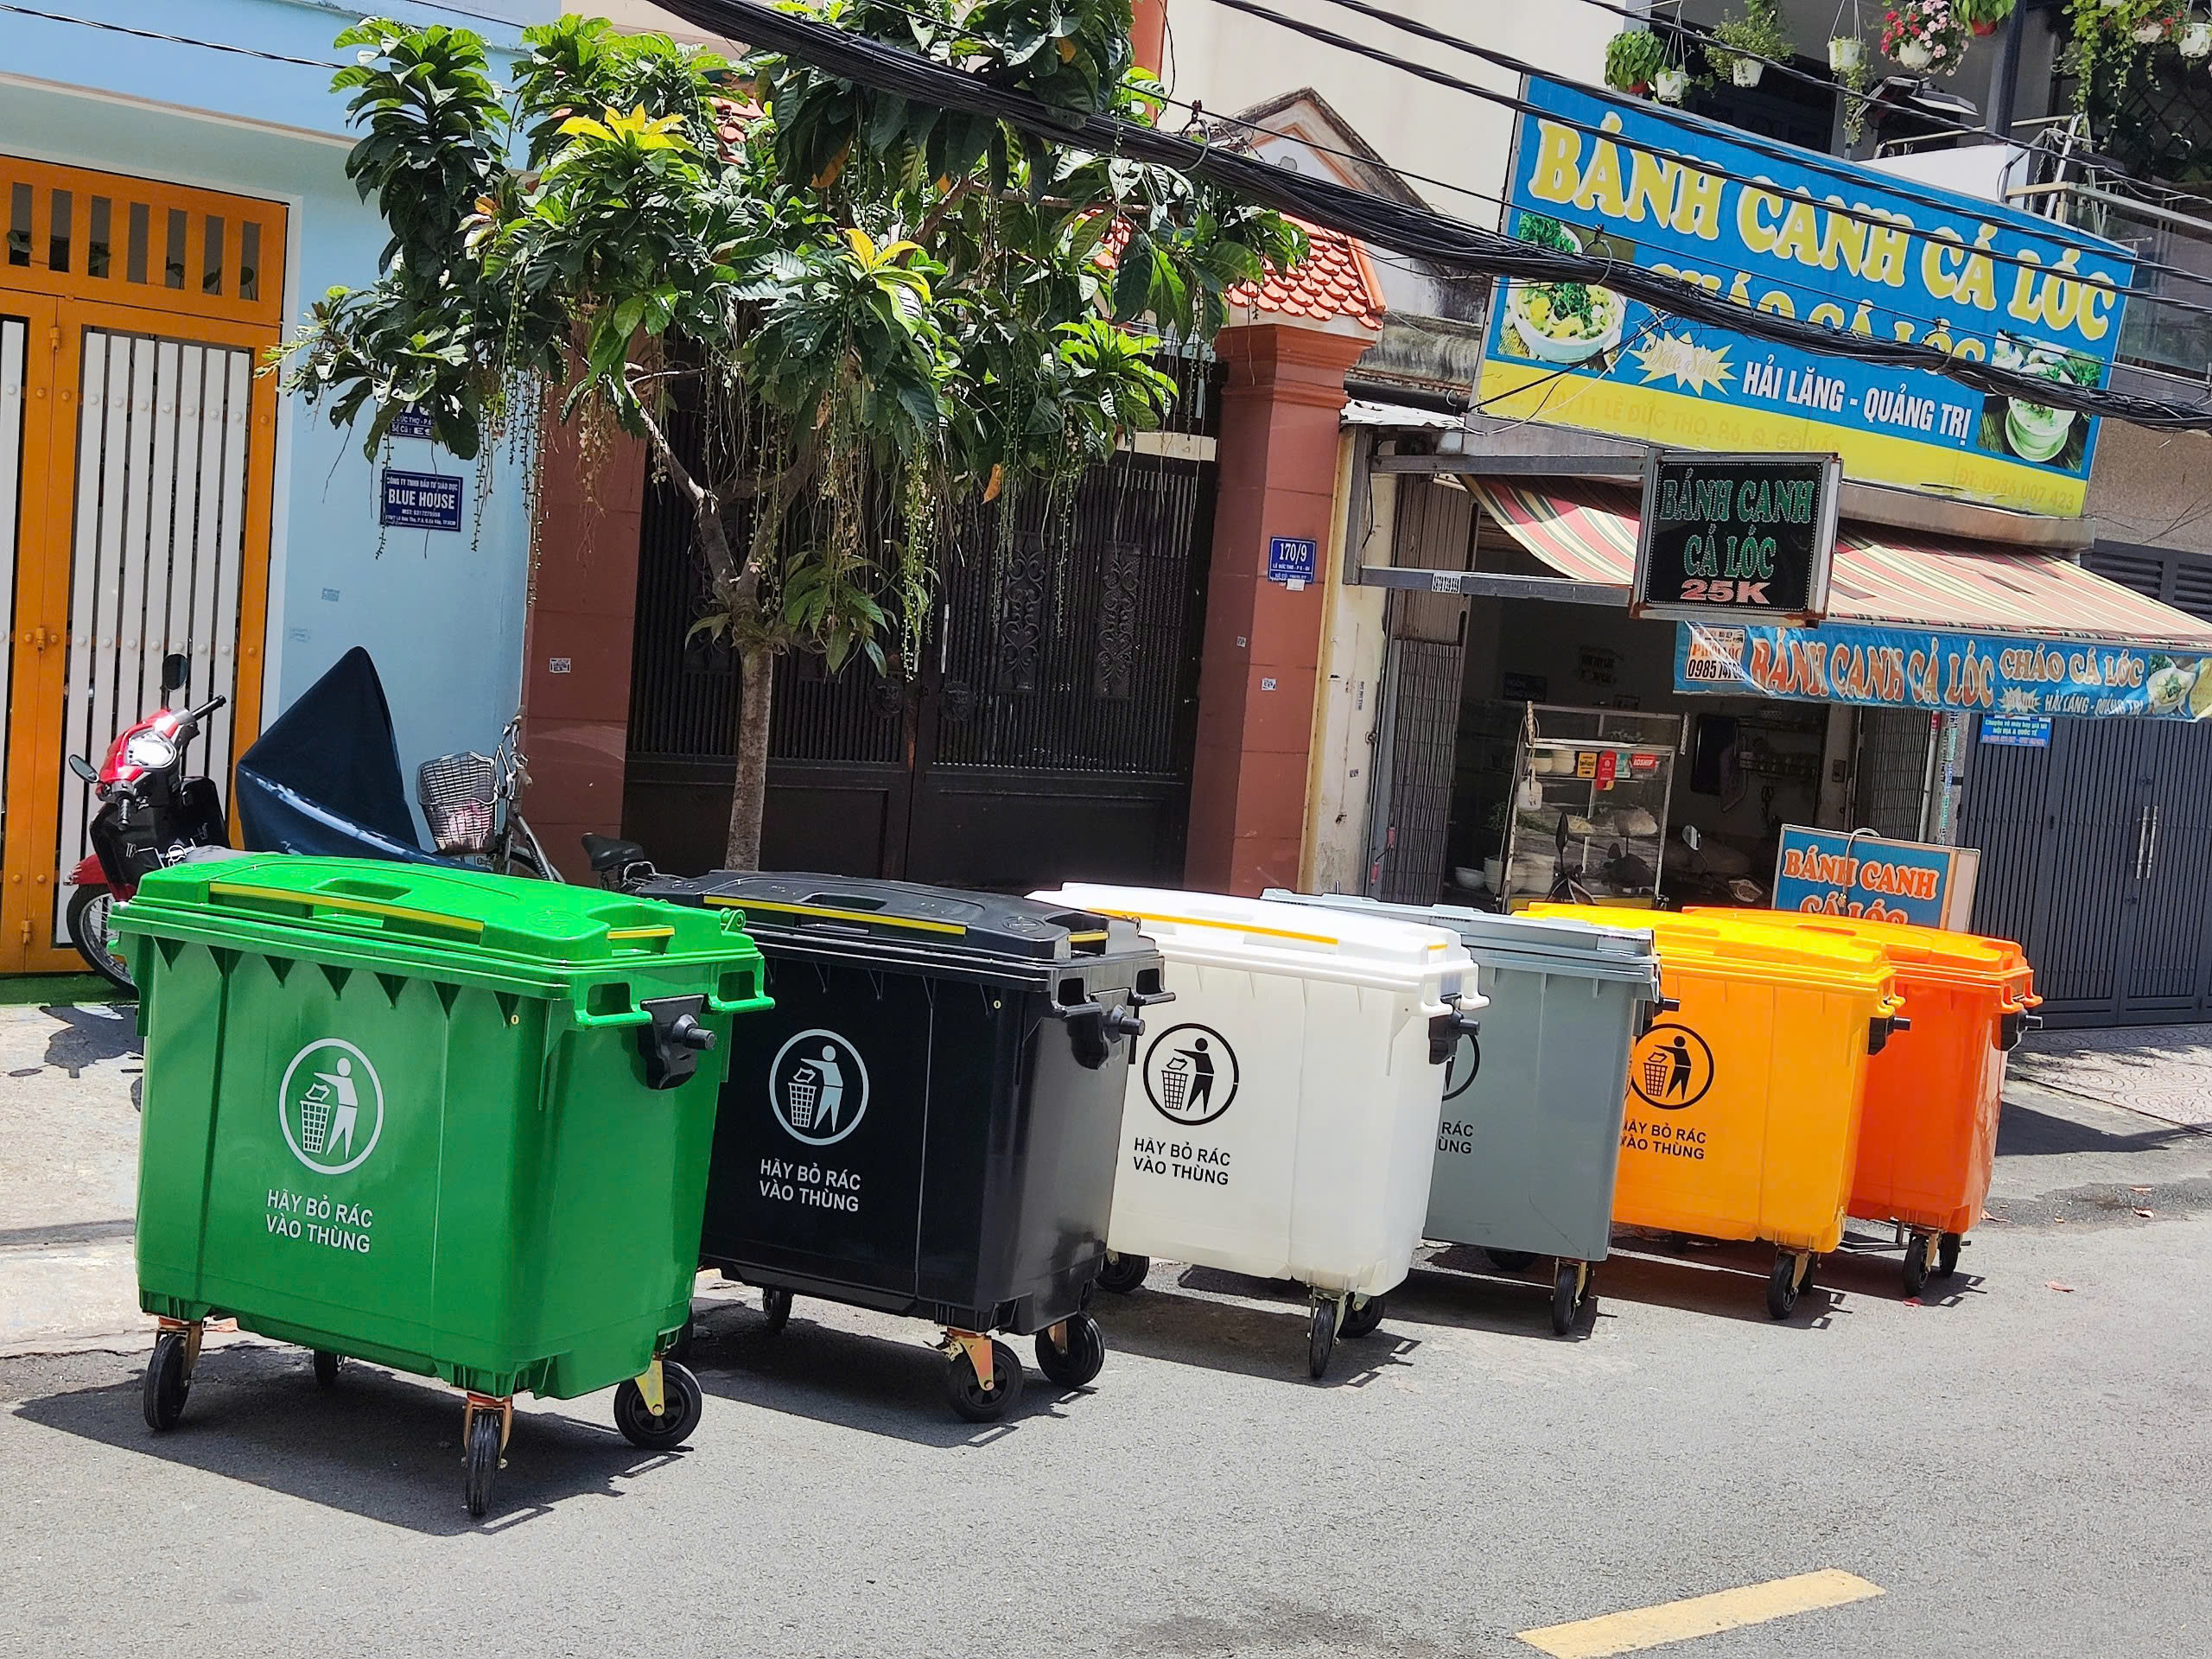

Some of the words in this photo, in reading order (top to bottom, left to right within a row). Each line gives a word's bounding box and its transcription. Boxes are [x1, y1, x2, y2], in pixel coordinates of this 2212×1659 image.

[1528, 111, 1726, 240] BÁNH
[1738, 175, 1914, 288] CANH
[1922, 222, 1999, 311] CÁ
[2007, 247, 2116, 340] LÓC
[1742, 353, 1783, 400] HẢI
[1786, 365, 1846, 413] LĂNG
[1863, 383, 1936, 431] QUẢNG
[1939, 403, 1972, 446] TRỊ
[388, 488, 416, 506] BLUE
[418, 491, 454, 510] HOUSE
[1659, 467, 1733, 522] BÁNH
[1737, 480, 1815, 524] CANH
[2020, 483, 2047, 504] 007
[2050, 490, 2075, 511] 423
[1279, 543, 1307, 565] 170/9
[1684, 523, 1719, 577] CÁ
[1724, 524, 1777, 580] LÓC
[1680, 579, 1771, 605] 25K
[1750, 626, 1828, 697] BÁNH
[1830, 642, 1904, 702] CANH
[1907, 636, 1941, 704] CÁ
[1944, 639, 1994, 709] LÓC
[1999, 642, 2065, 683] CHÁO
[2069, 646, 2101, 685] CÁ
[2104, 648, 2145, 689] LÓC
[1783, 844, 1859, 887] BÁNH
[1859, 861, 1940, 900] CANH
[1438, 1135, 1471, 1154] ÙNG
[1441, 1120, 1474, 1137] RÁC
[1651, 1122, 1672, 1139] BỎ
[1675, 1128, 1707, 1144] RÁC
[1134, 1136, 1166, 1155] HÃY
[1170, 1141, 1192, 1160] BỎ
[1197, 1147, 1230, 1166] RÁC
[1621, 1134, 1648, 1150] VÀO
[1652, 1141, 1705, 1160] THÙNG
[760, 1158, 793, 1179] HÃY
[797, 1162, 821, 1184] BỎ
[825, 1168, 861, 1191] RÁC
[1133, 1154, 1166, 1175] VÀO
[1172, 1163, 1229, 1185] THÙNG
[267, 1188, 302, 1213] HÃY
[305, 1193, 331, 1220] BỎ
[335, 1203, 373, 1228] RÁC
[760, 1179, 794, 1201] VÀO
[799, 1187, 859, 1212] THÙNG
[265, 1212, 302, 1238] VÀO
[307, 1224, 371, 1253] THÙNG
